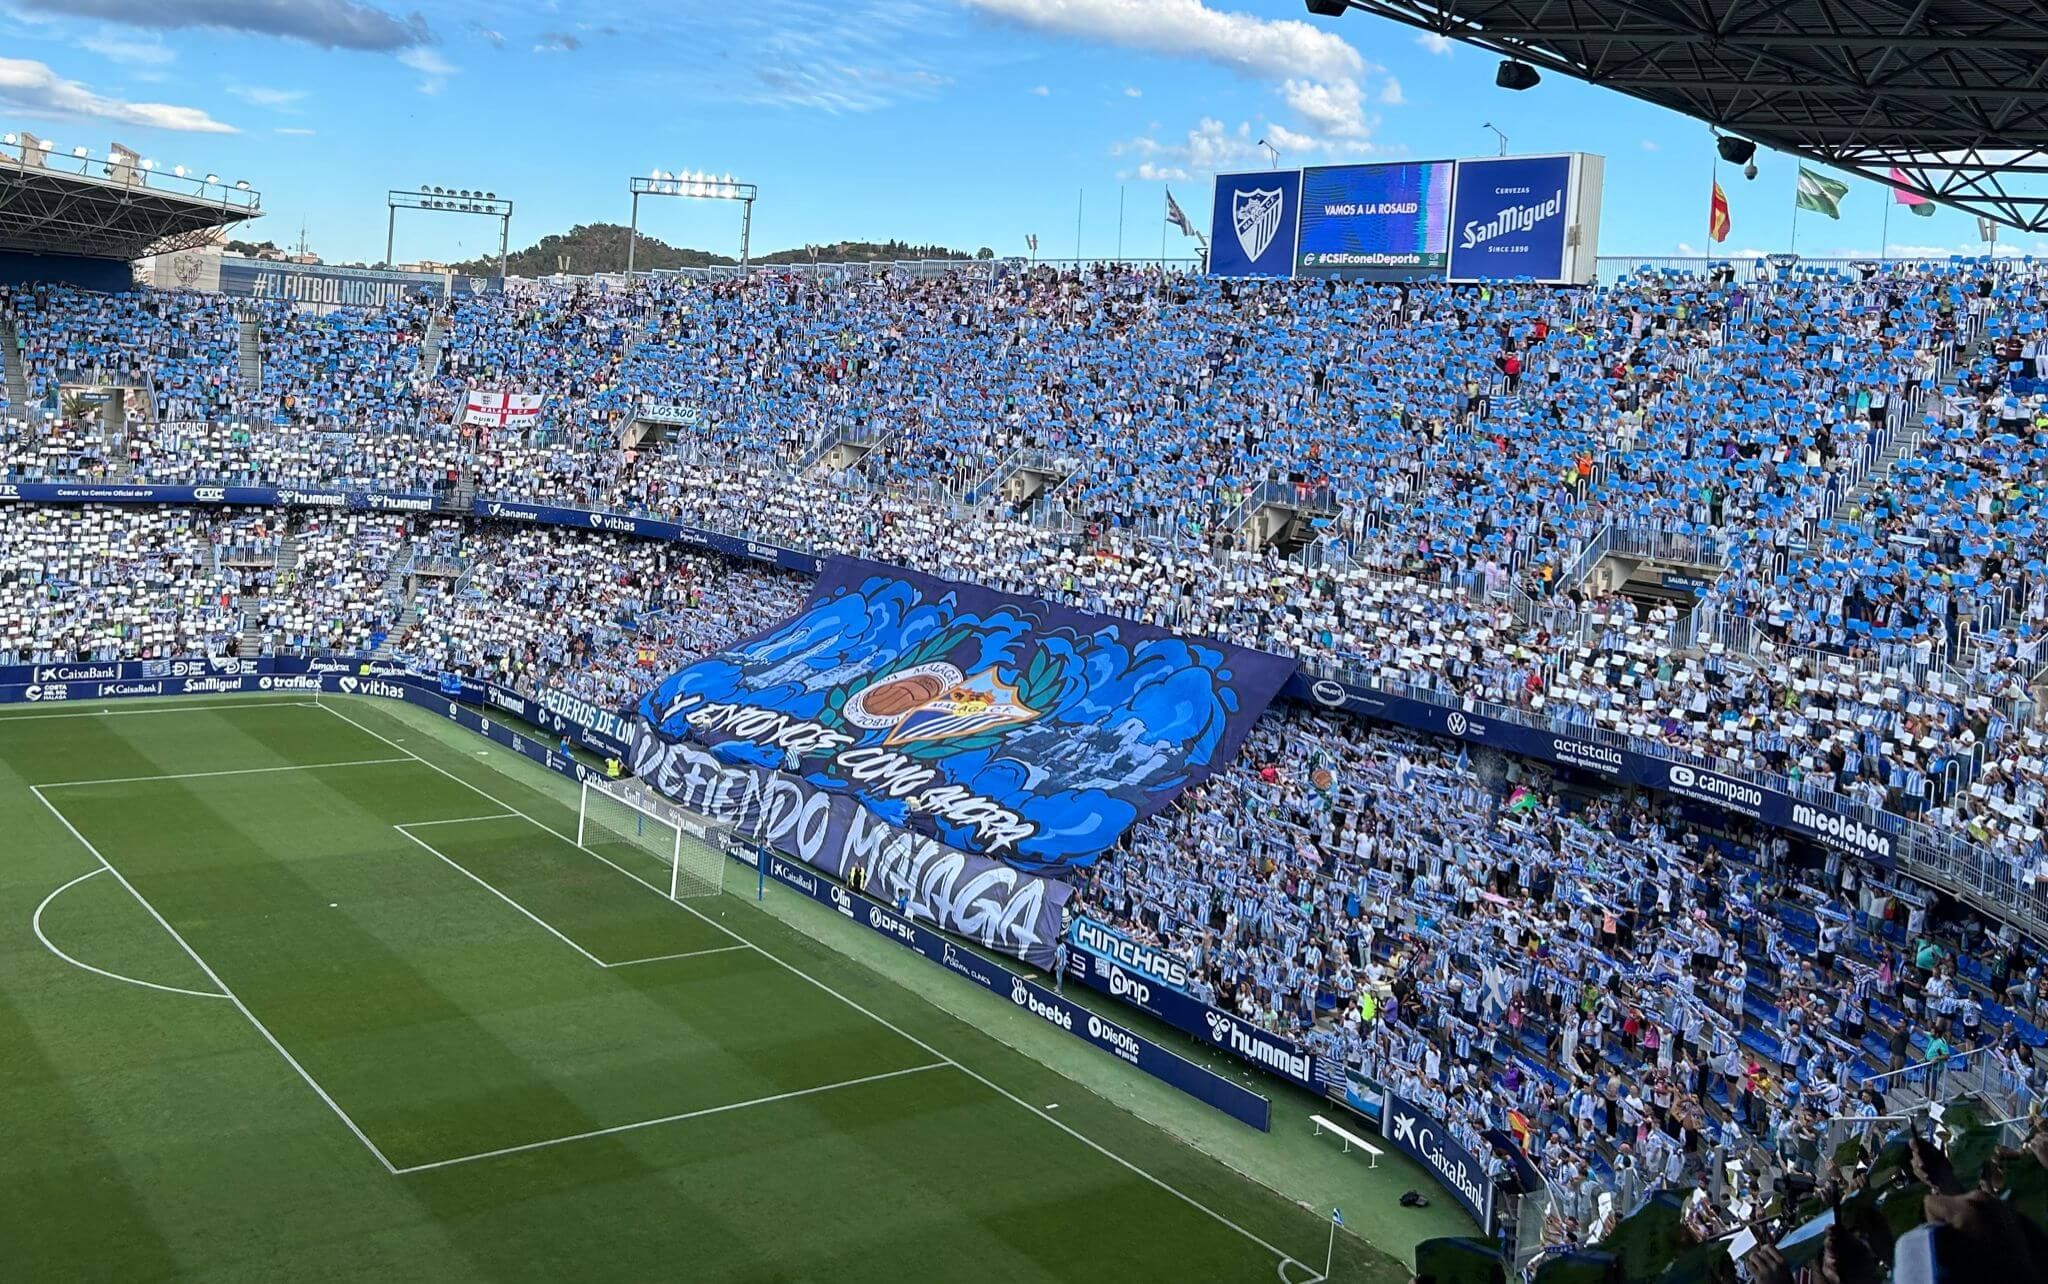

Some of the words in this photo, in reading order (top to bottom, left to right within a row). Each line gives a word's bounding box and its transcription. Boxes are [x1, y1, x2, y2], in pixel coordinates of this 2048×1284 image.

[1495, 187, 1530, 195] CERVEZAS
[1324, 204, 1355, 216] VAMOS
[1356, 204, 1364, 214] A
[1365, 203, 1377, 214] LA
[1378, 203, 1418, 214] ROSALED
[1510, 245, 1529, 253] 1890
[1318, 253, 1420, 267] #CSIFconelDeporte
[652, 406, 672, 417] LOS
[673, 407, 694, 419] 300
[293, 492, 345, 506] hummel
[383, 495, 433, 511] hummel
[500, 508, 538, 521] Sanamar
[604, 517, 636, 532] vithas
[58, 666, 115, 680] CaixaBank
[273, 675, 322, 689] trafilex
[115, 682, 157, 695] CaixaBank
[360, 680, 404, 698] vithas
[497, 689, 525, 715] hummel
[661, 693, 702, 724] Y
[595, 708, 615, 736] DE
[616, 720, 637, 746] UN
[1553, 738, 1623, 765] acristalia
[836, 747, 937, 797] COMO
[1602, 763, 1619, 774] estar
[677, 814, 707, 841] hummel
[781, 866, 814, 892] CaixaBank
[830, 885, 851, 909] Olin
[881, 914, 916, 943] DFSK
[1078, 921, 1188, 989] HINCHAS
[1028, 992, 1073, 1030] beebé
[1102, 1023, 1140, 1056] DisOfic
[1230, 1022, 1311, 1083] hummel
[1418, 1128, 1485, 1217] CaixaBank
